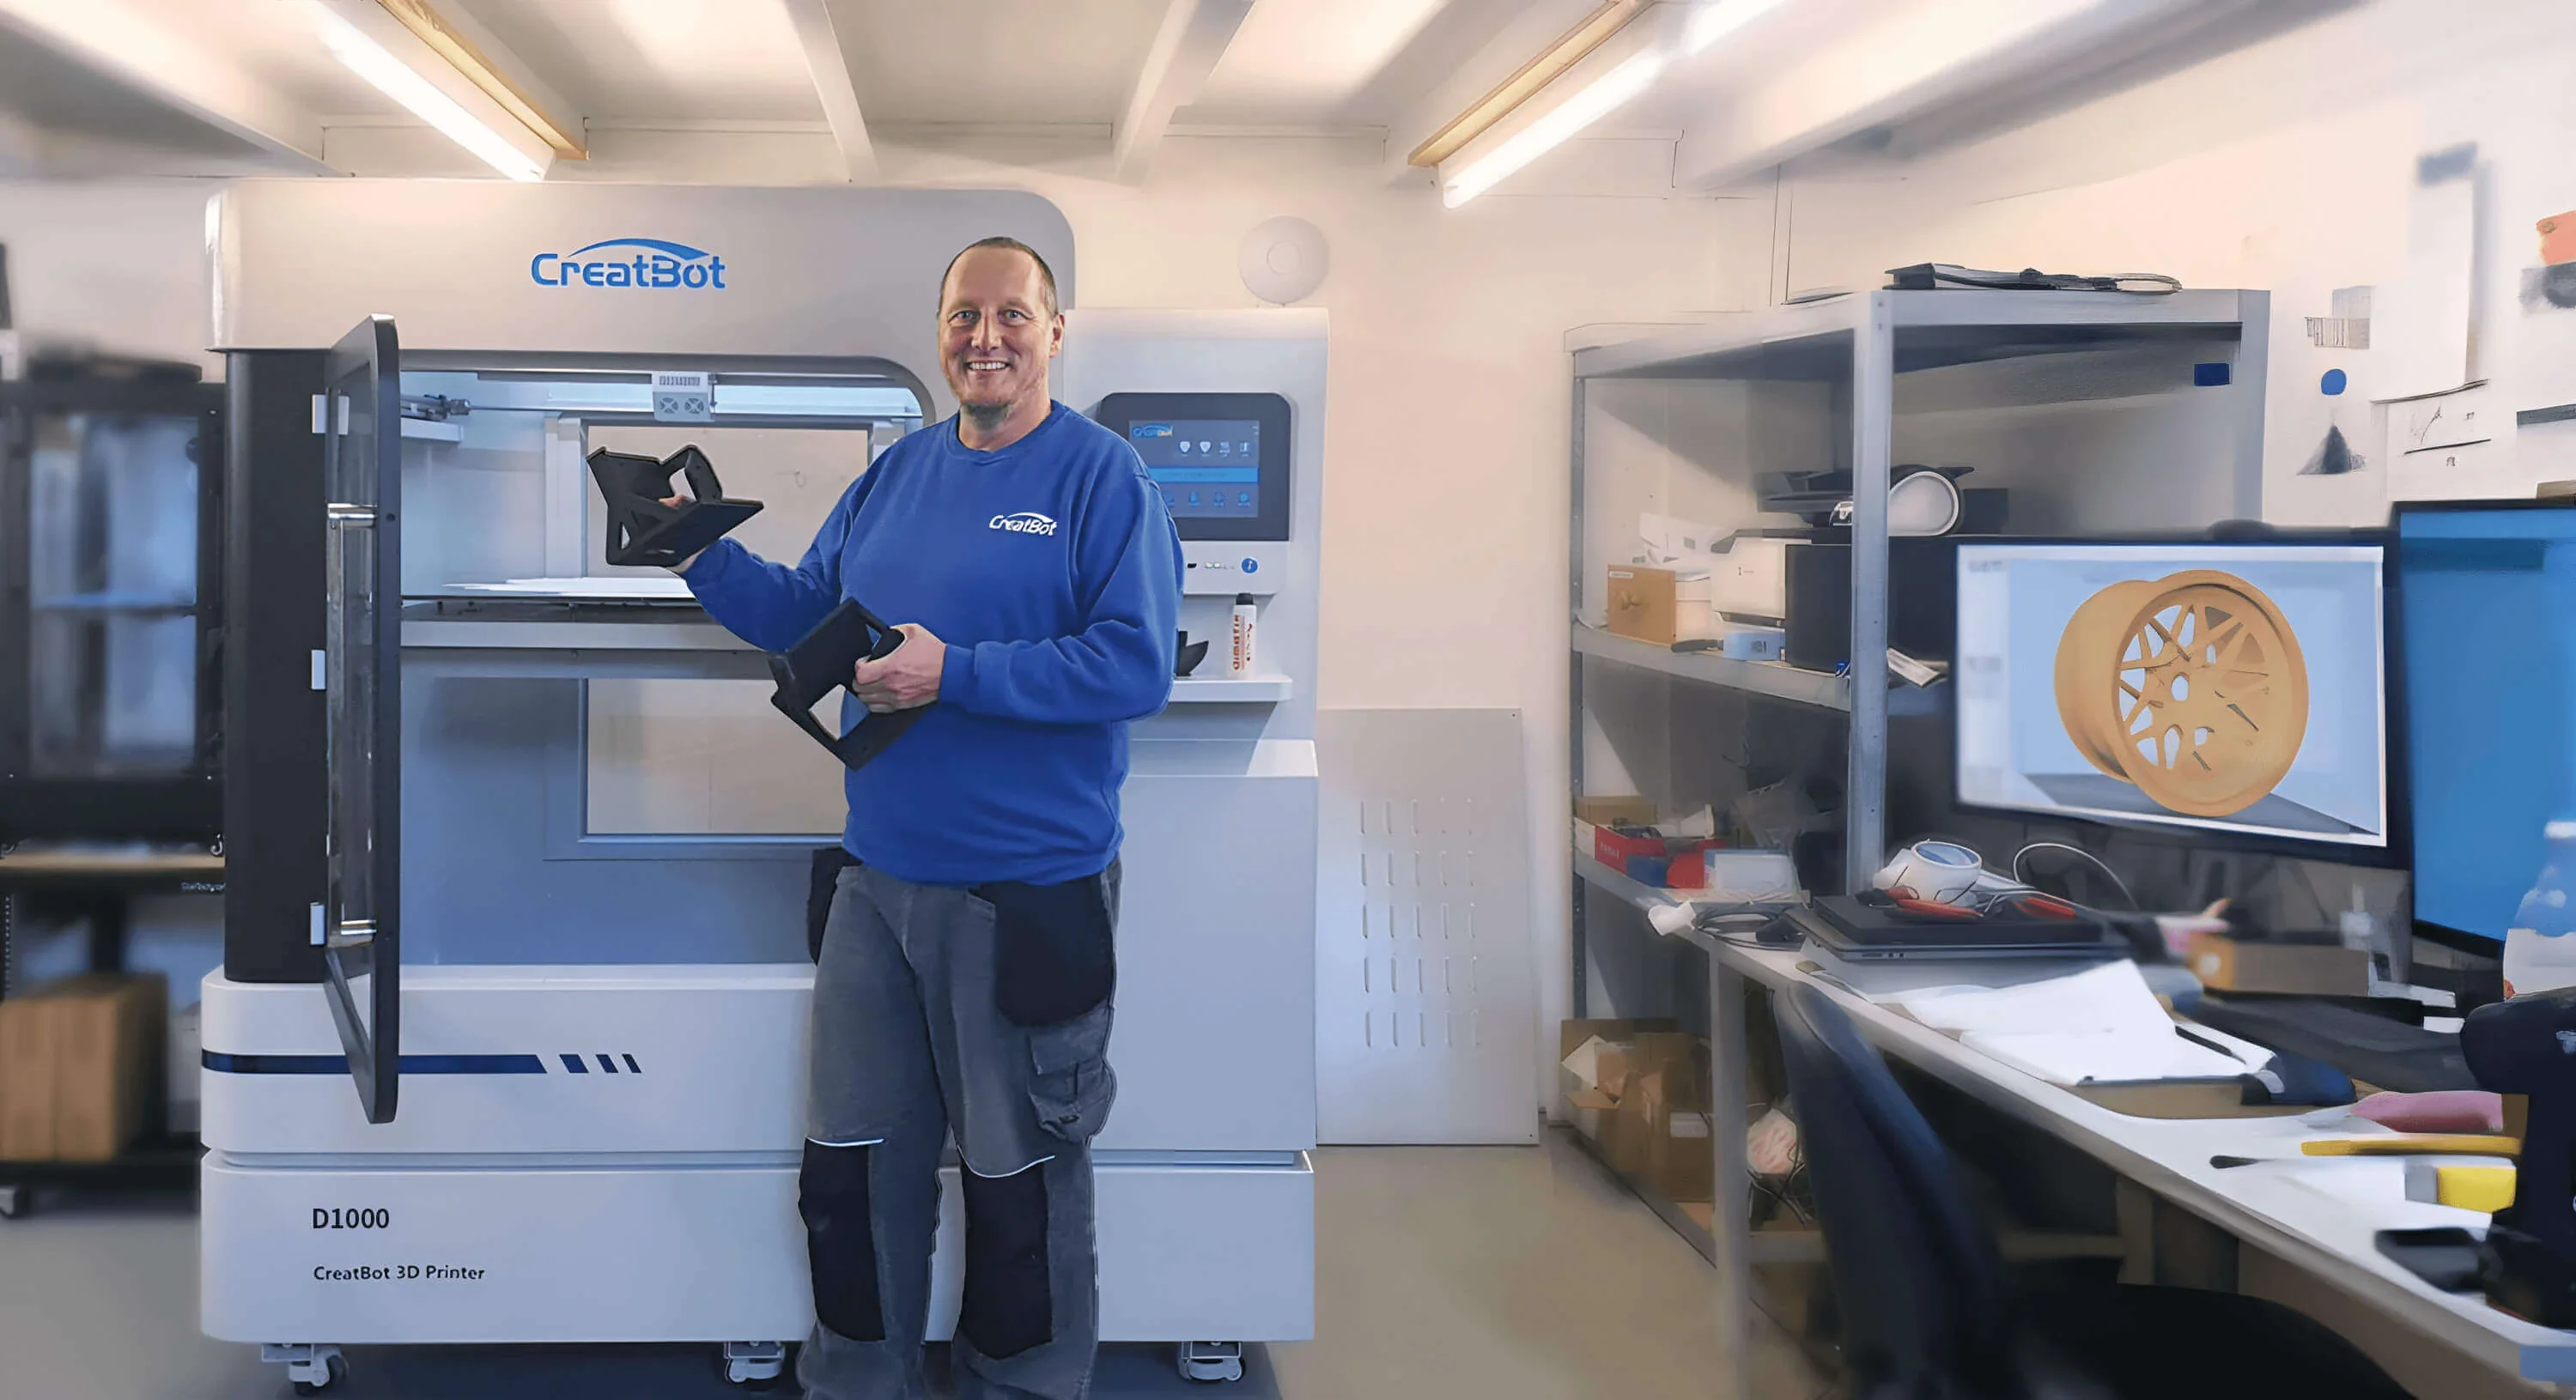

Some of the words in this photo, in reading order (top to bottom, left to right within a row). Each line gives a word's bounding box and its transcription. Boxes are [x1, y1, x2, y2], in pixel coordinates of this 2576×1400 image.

[531, 252, 726, 289] CreatBot
[988, 514, 1057, 536] CreatBot
[313, 1208, 390, 1229] D1000
[313, 1265, 391, 1281] CreatBot
[397, 1265, 420, 1279] 3D
[426, 1264, 485, 1280] Printer
